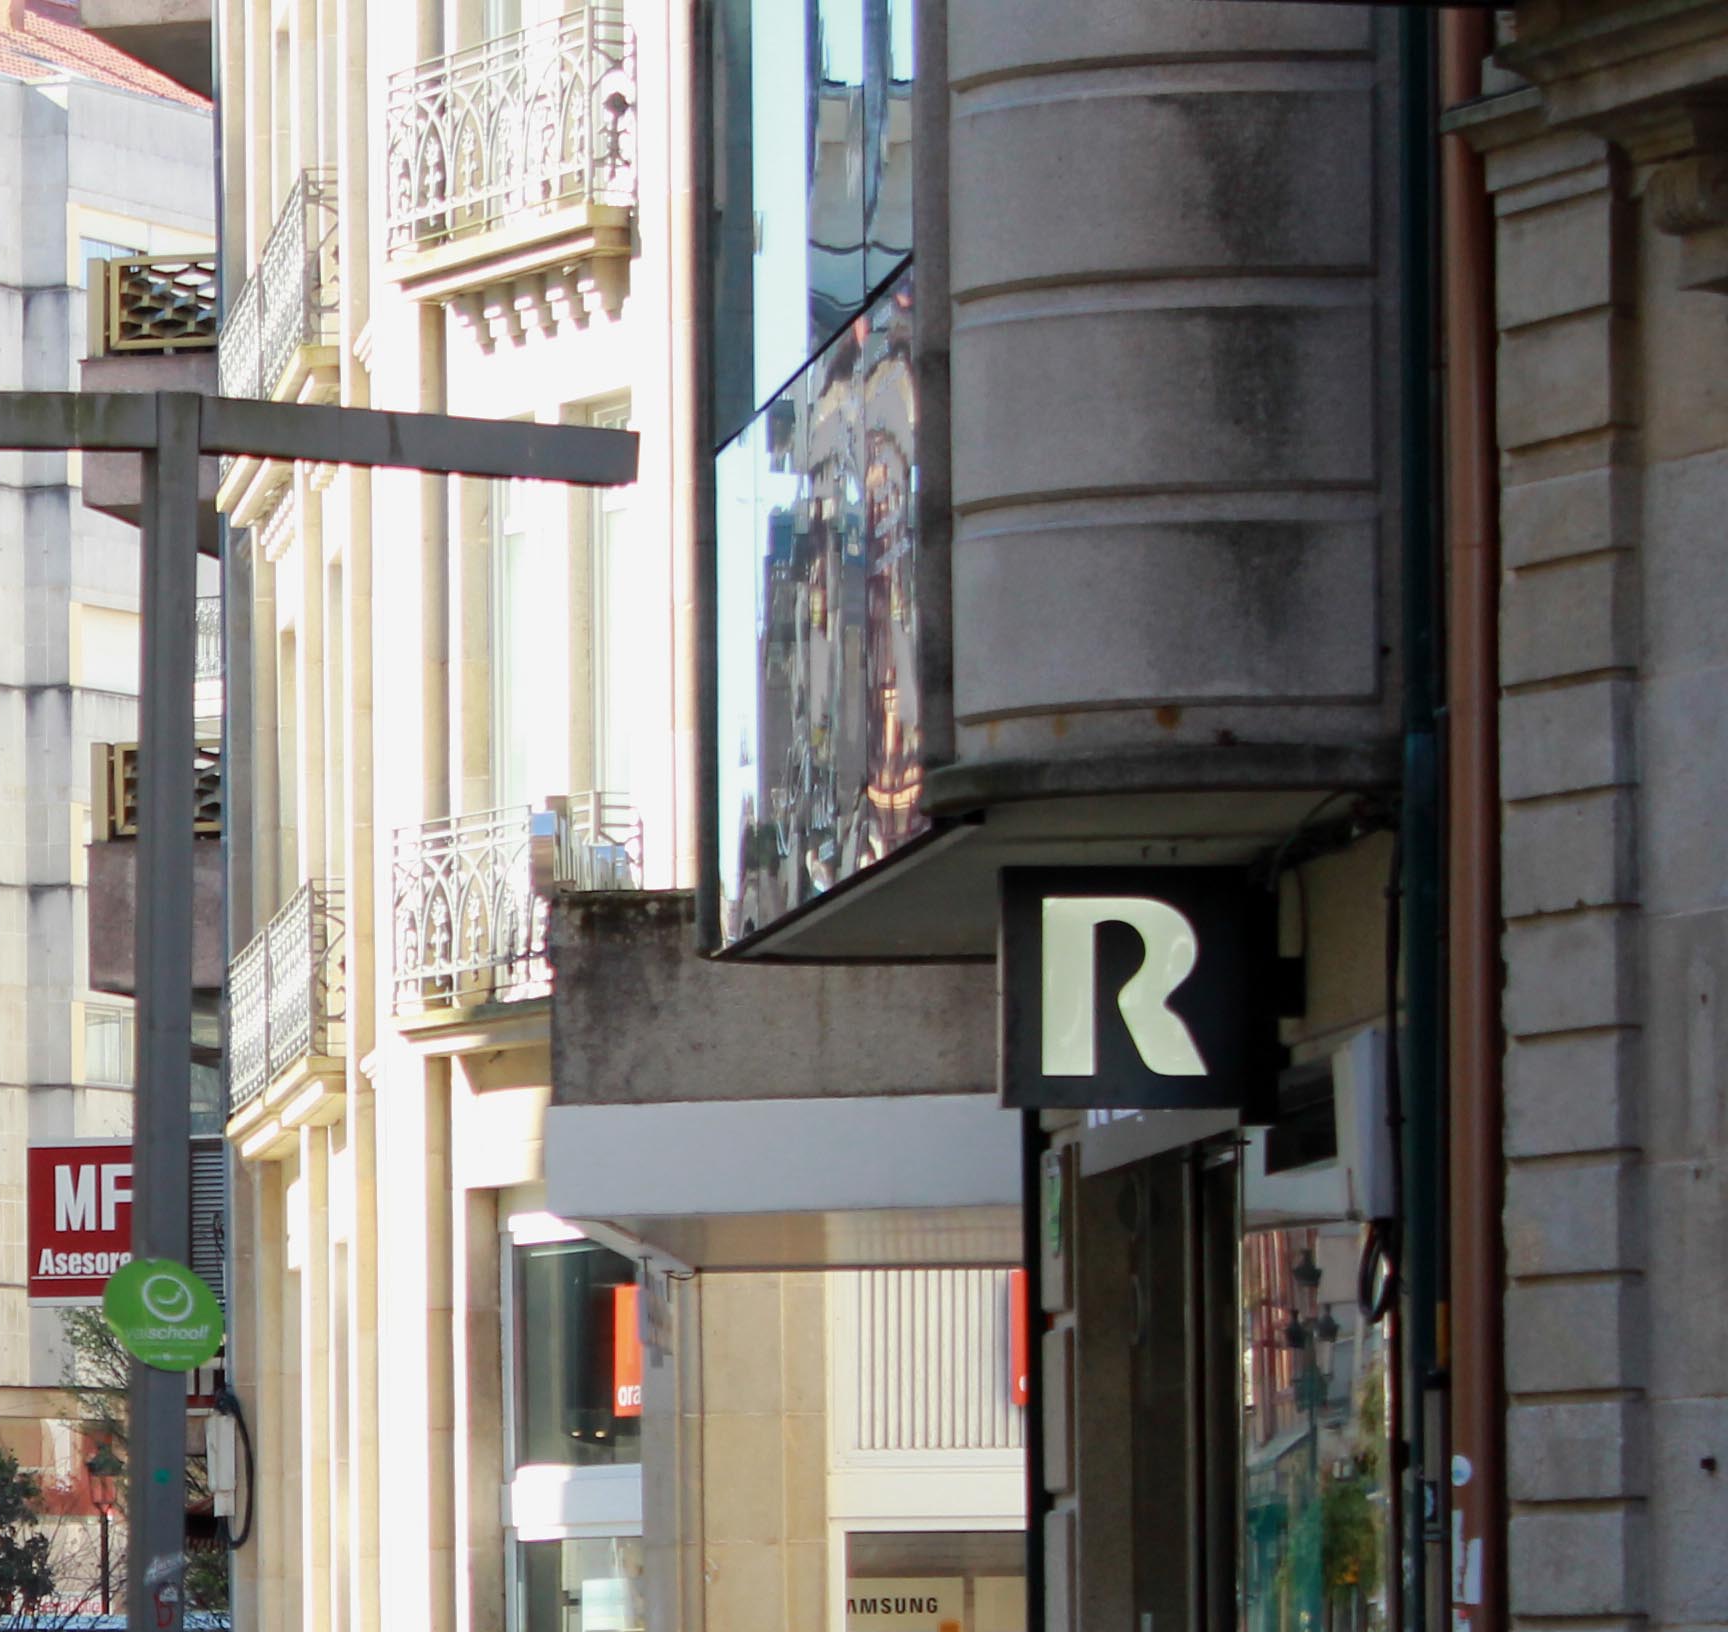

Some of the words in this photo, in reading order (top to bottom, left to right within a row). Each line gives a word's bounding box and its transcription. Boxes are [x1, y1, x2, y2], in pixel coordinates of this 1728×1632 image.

[1041, 897, 1208, 1077] R
[55, 1164, 133, 1231] MF
[38, 1248, 133, 1275] Asesore
[618, 1384, 641, 1406] ora
[848, 1597, 938, 1614] AMSUNG
